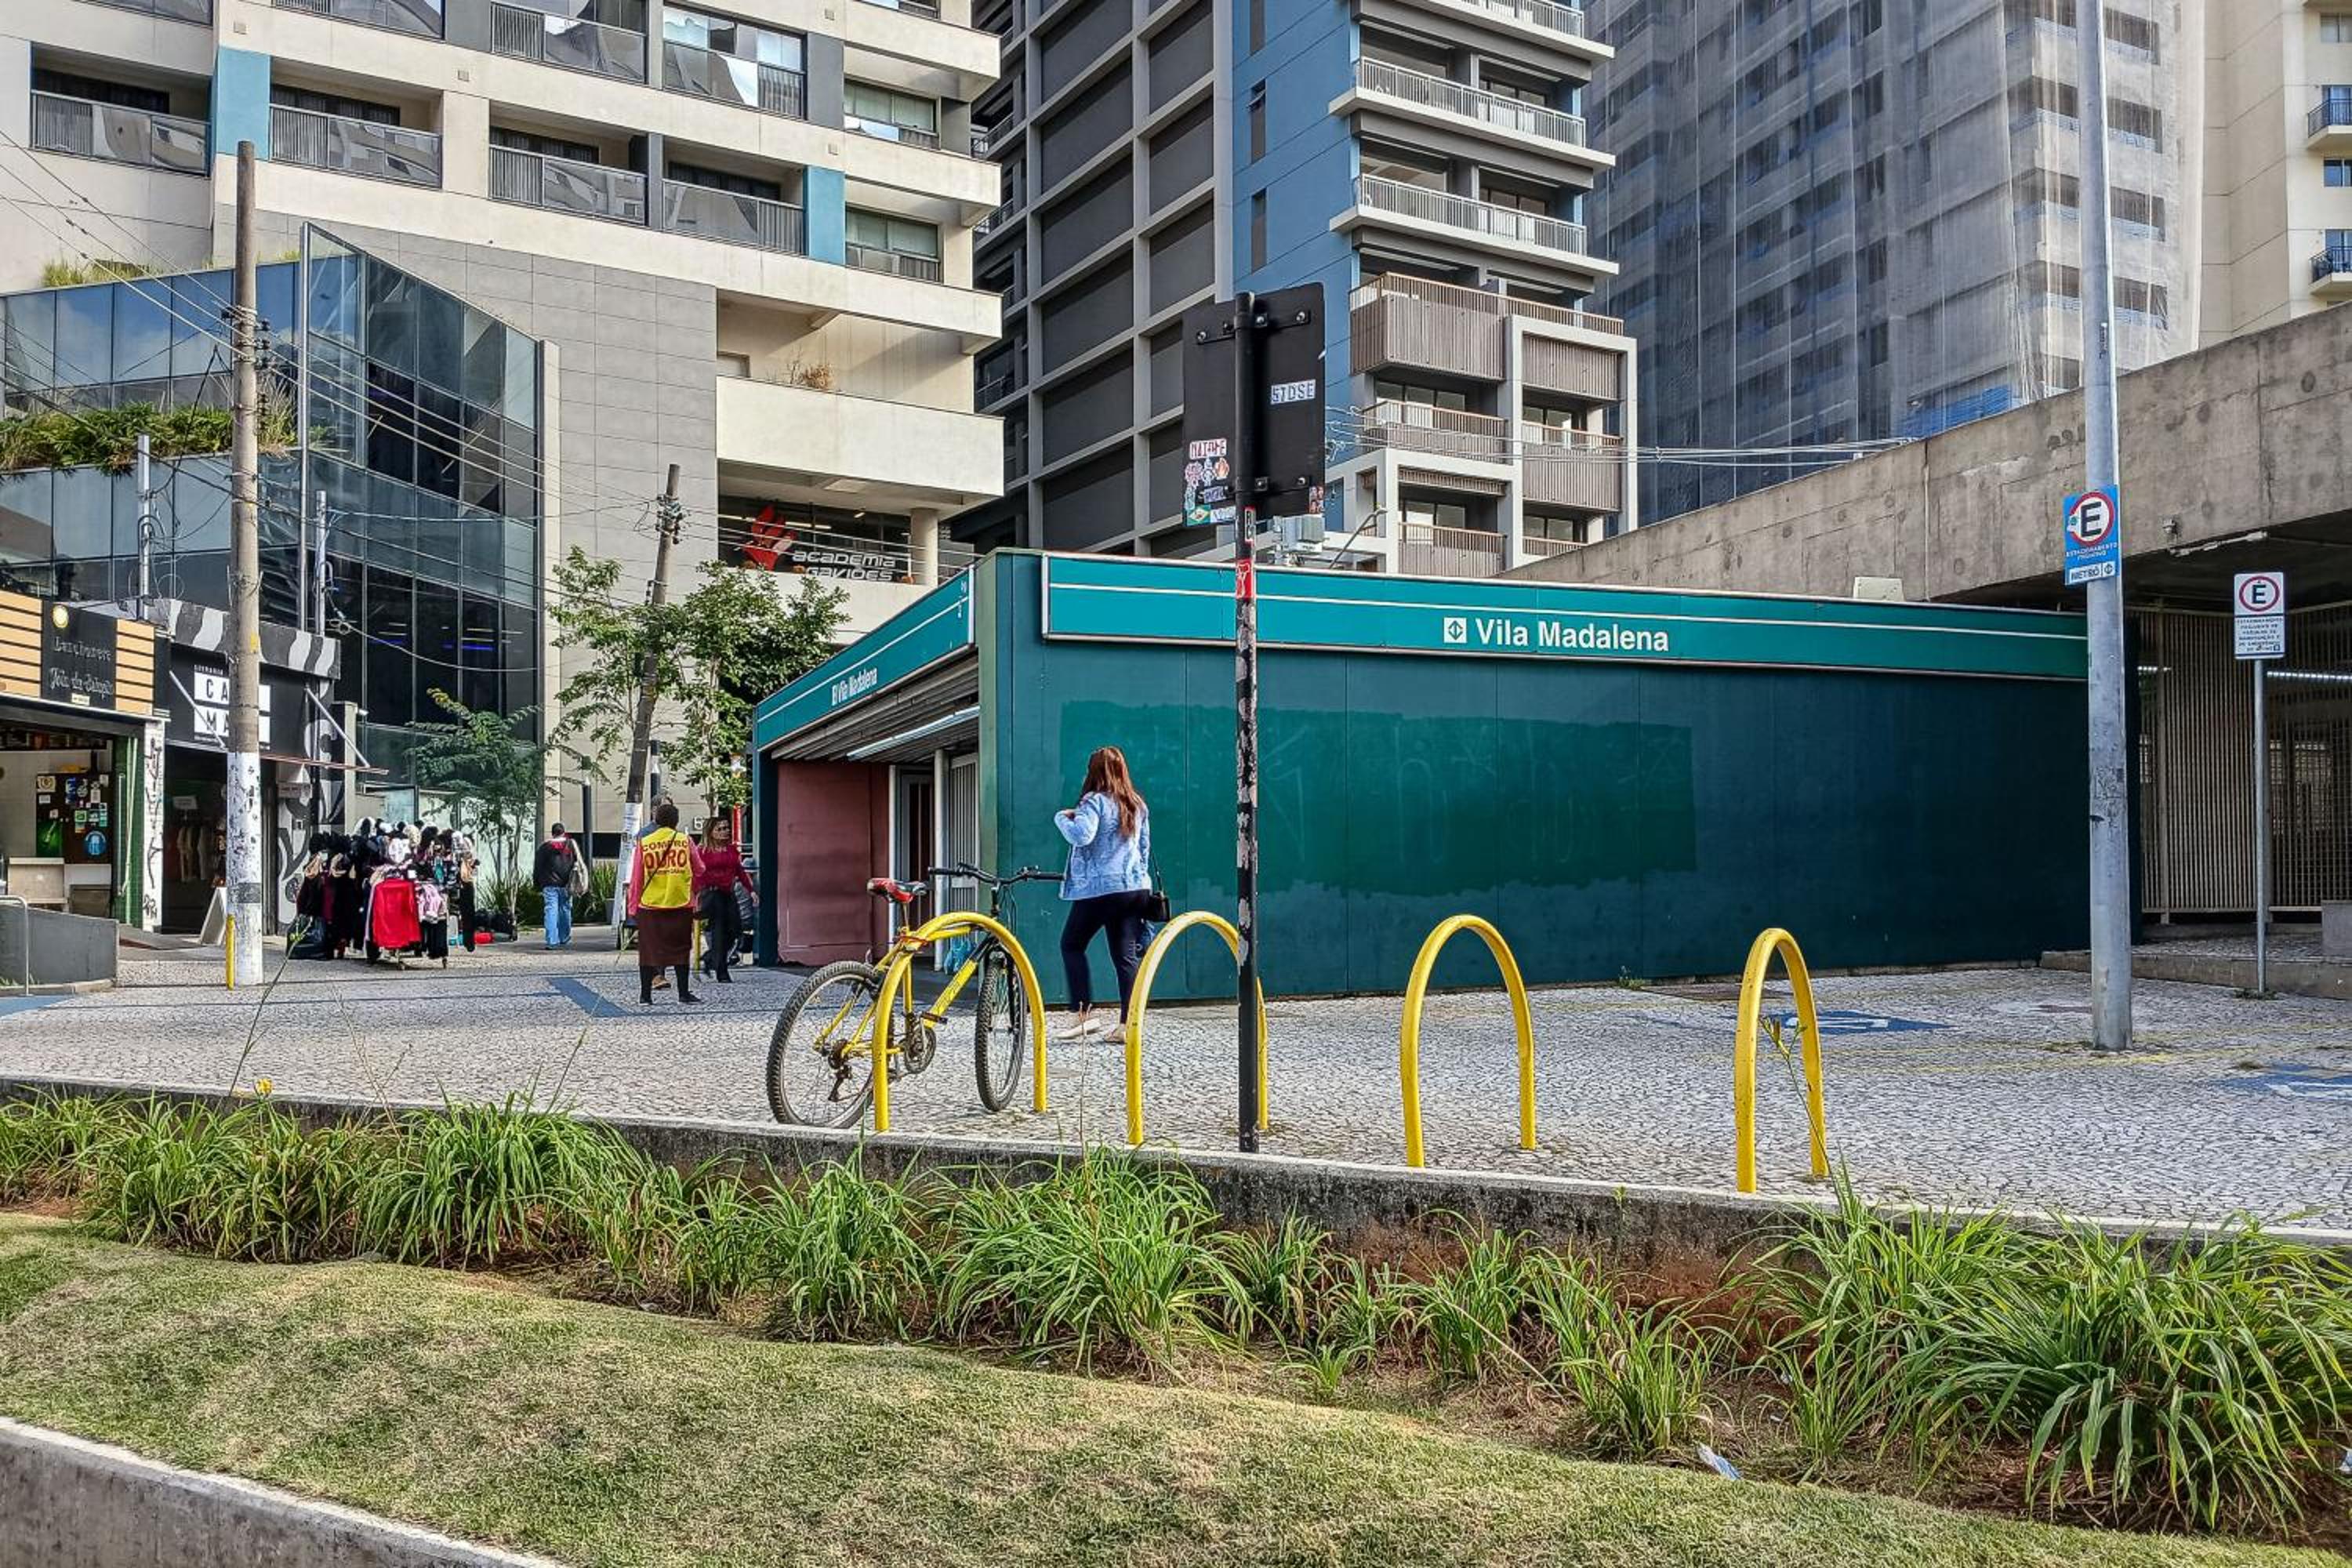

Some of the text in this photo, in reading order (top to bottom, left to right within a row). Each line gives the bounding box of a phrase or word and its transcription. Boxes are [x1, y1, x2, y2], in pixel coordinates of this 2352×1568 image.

[2081, 502, 2102, 537] E
[806, 565, 894, 582] GAVIÕES
[2252, 584, 2267, 604] E
[1475, 617, 1669, 652] Vila Madalena
[644, 849, 688, 869] OURO
